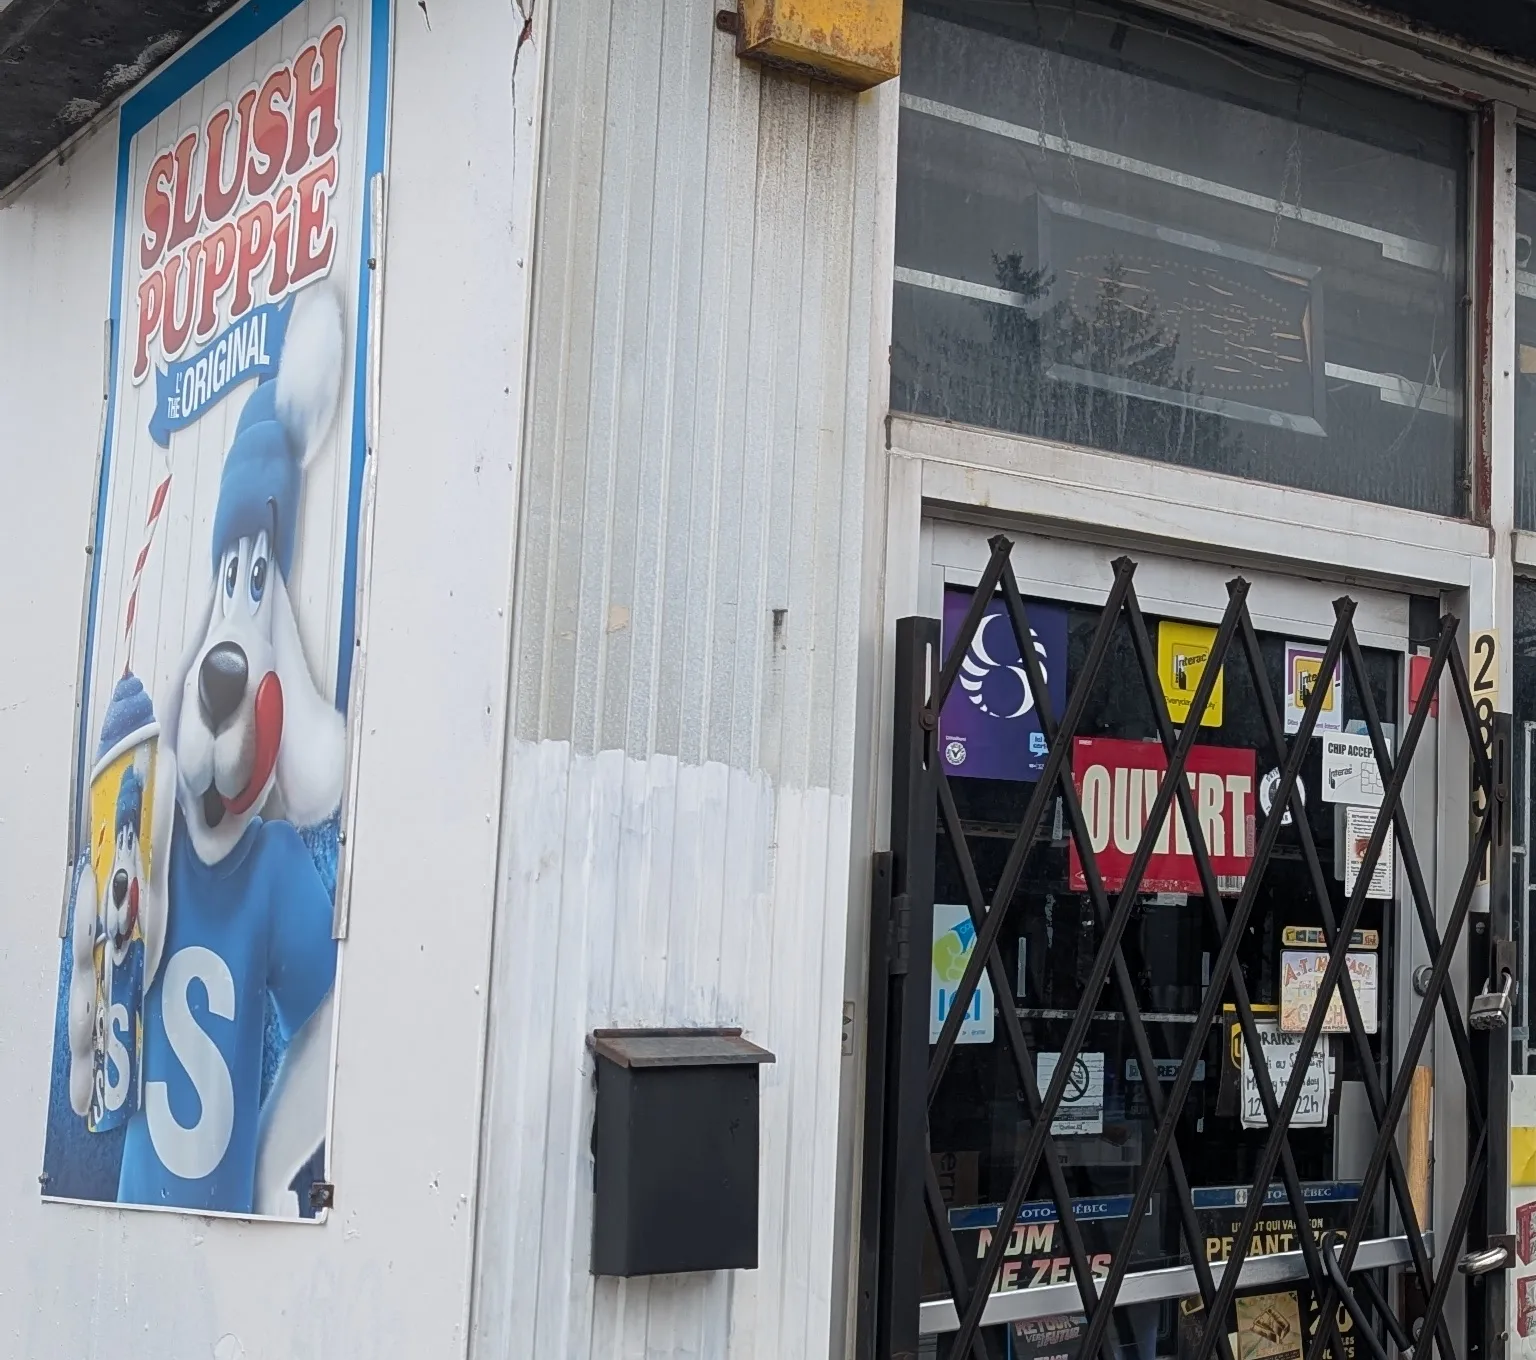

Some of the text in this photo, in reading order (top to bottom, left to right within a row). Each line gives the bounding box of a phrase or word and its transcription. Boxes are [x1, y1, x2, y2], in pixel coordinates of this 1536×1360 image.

[141, 24, 345, 269] SLUSH
[181, 314, 270, 418] ORIGINAL
[1328, 743, 1346, 755] CHIP
[146, 947, 234, 1179] S
